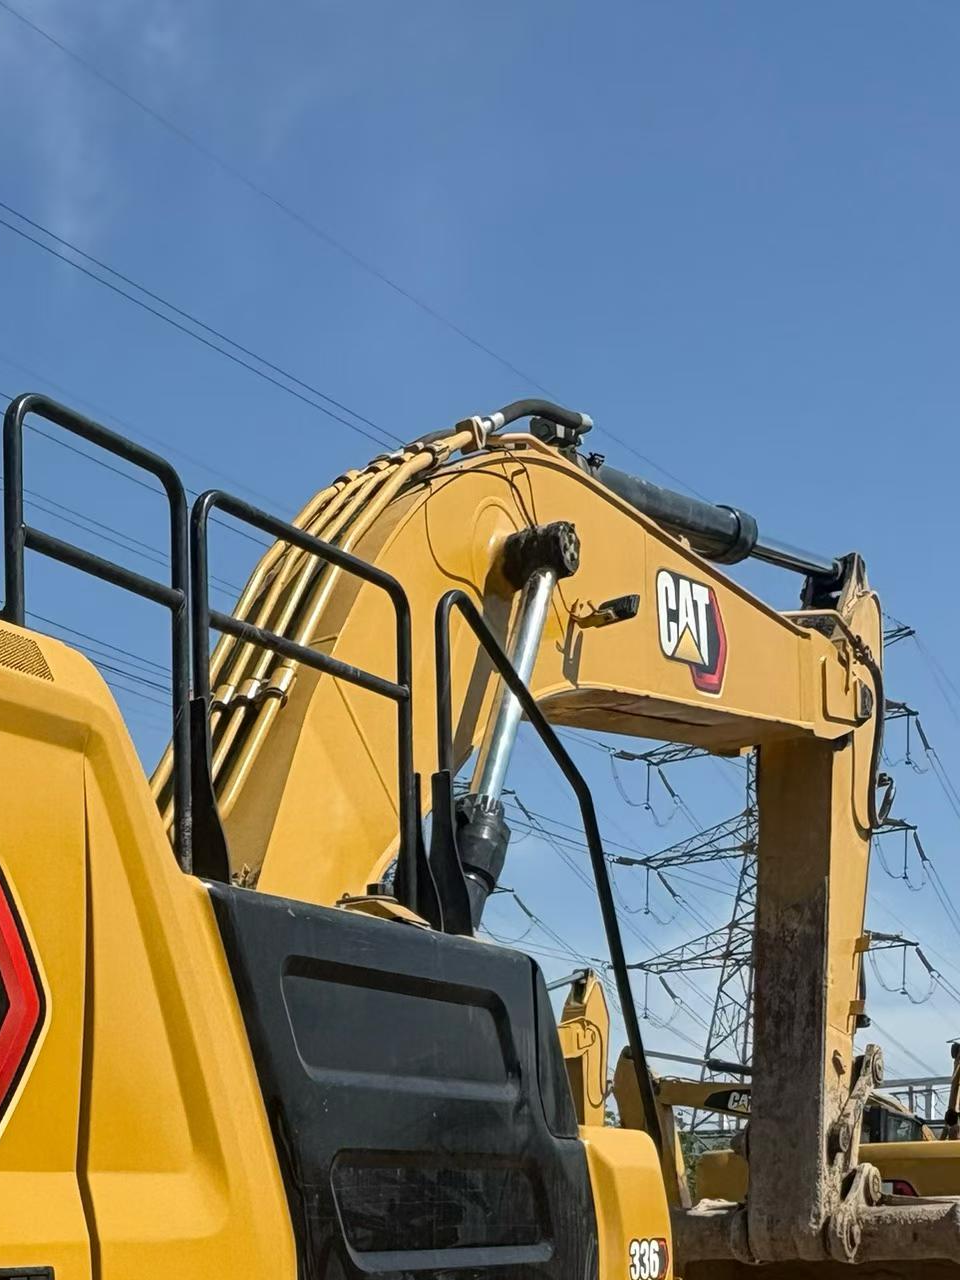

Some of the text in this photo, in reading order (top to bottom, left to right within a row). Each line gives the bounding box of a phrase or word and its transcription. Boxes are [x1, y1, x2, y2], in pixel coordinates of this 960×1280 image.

[657, 570, 710, 666] CAT
[728, 1091, 752, 1112] CA
[630, 1240, 660, 1280] 336
